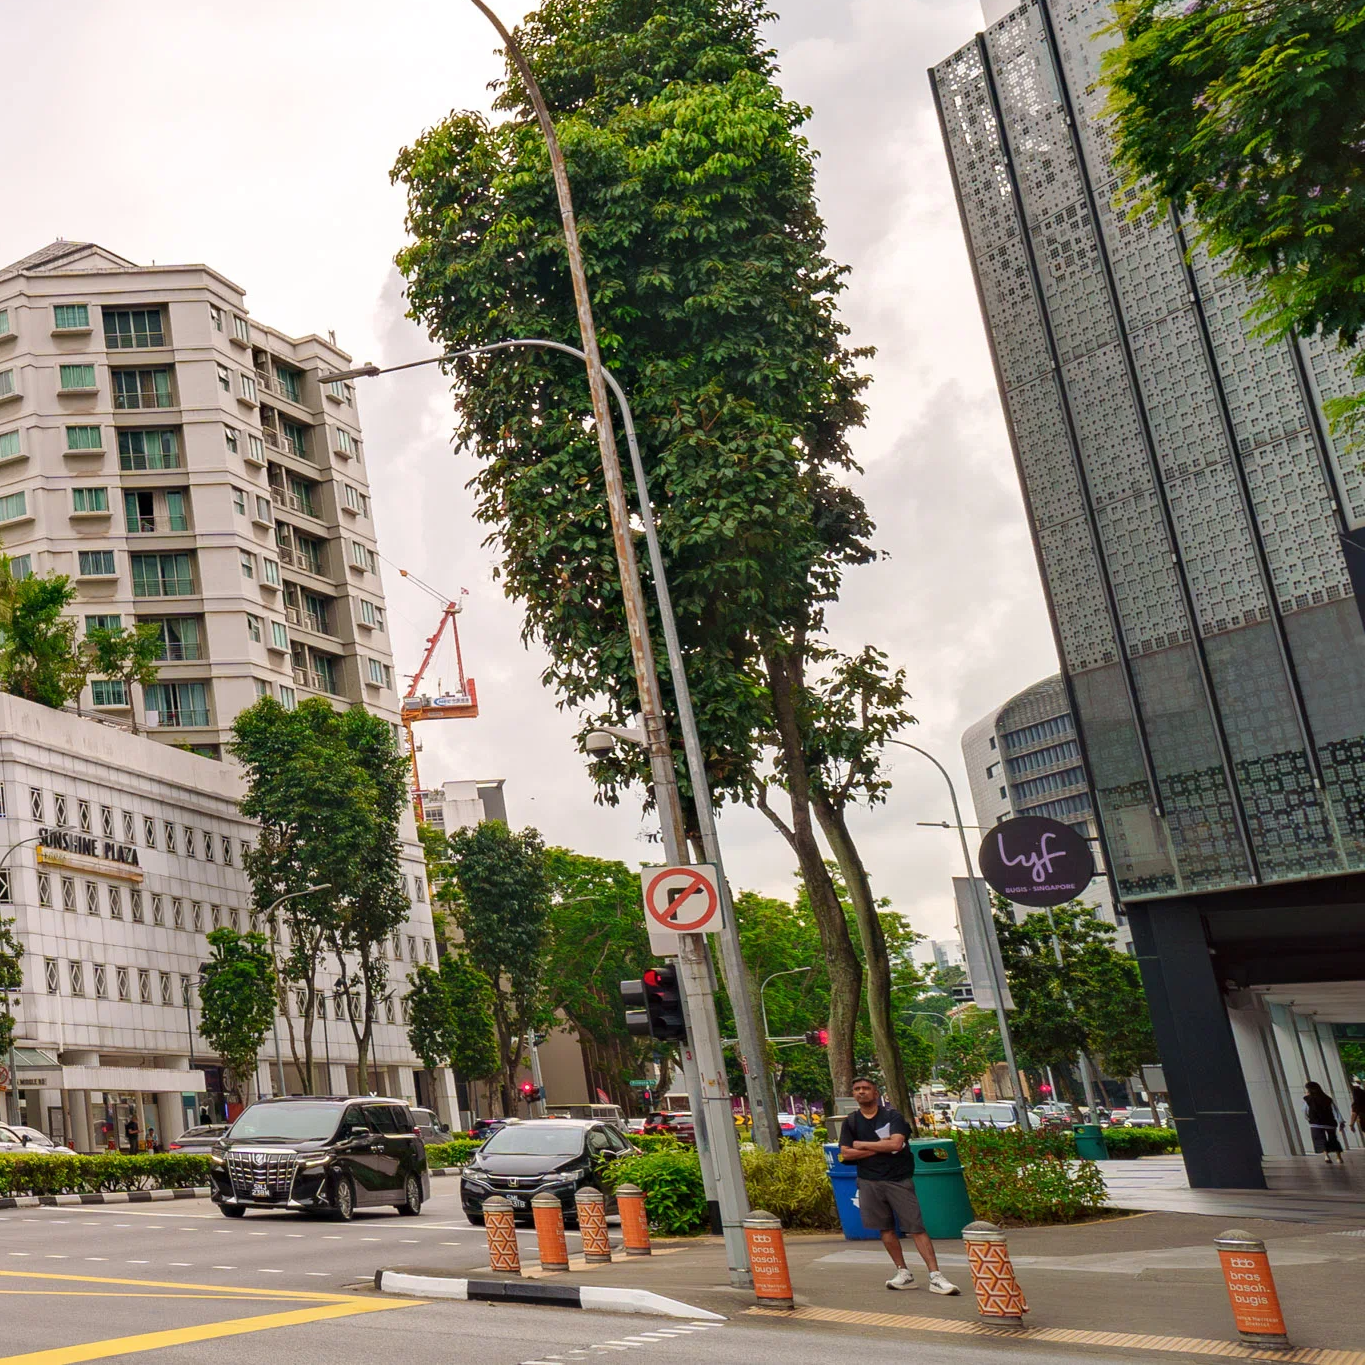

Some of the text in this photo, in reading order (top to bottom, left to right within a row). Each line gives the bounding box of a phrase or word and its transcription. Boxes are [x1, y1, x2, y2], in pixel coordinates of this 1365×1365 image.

[105, 841, 139, 867] PLAZA
[997, 832, 1066, 883] lyf
[1005, 883, 1076, 894] BUGIS SINGAPORE
[752, 1245, 775, 1254] bras
[751, 1255, 781, 1263] basah.
[755, 1265, 780, 1276] bugis
[1229, 1270, 1261, 1282] bras
[1228, 1282, 1271, 1292] basah.
[1234, 1293, 1268, 1306] bugis
